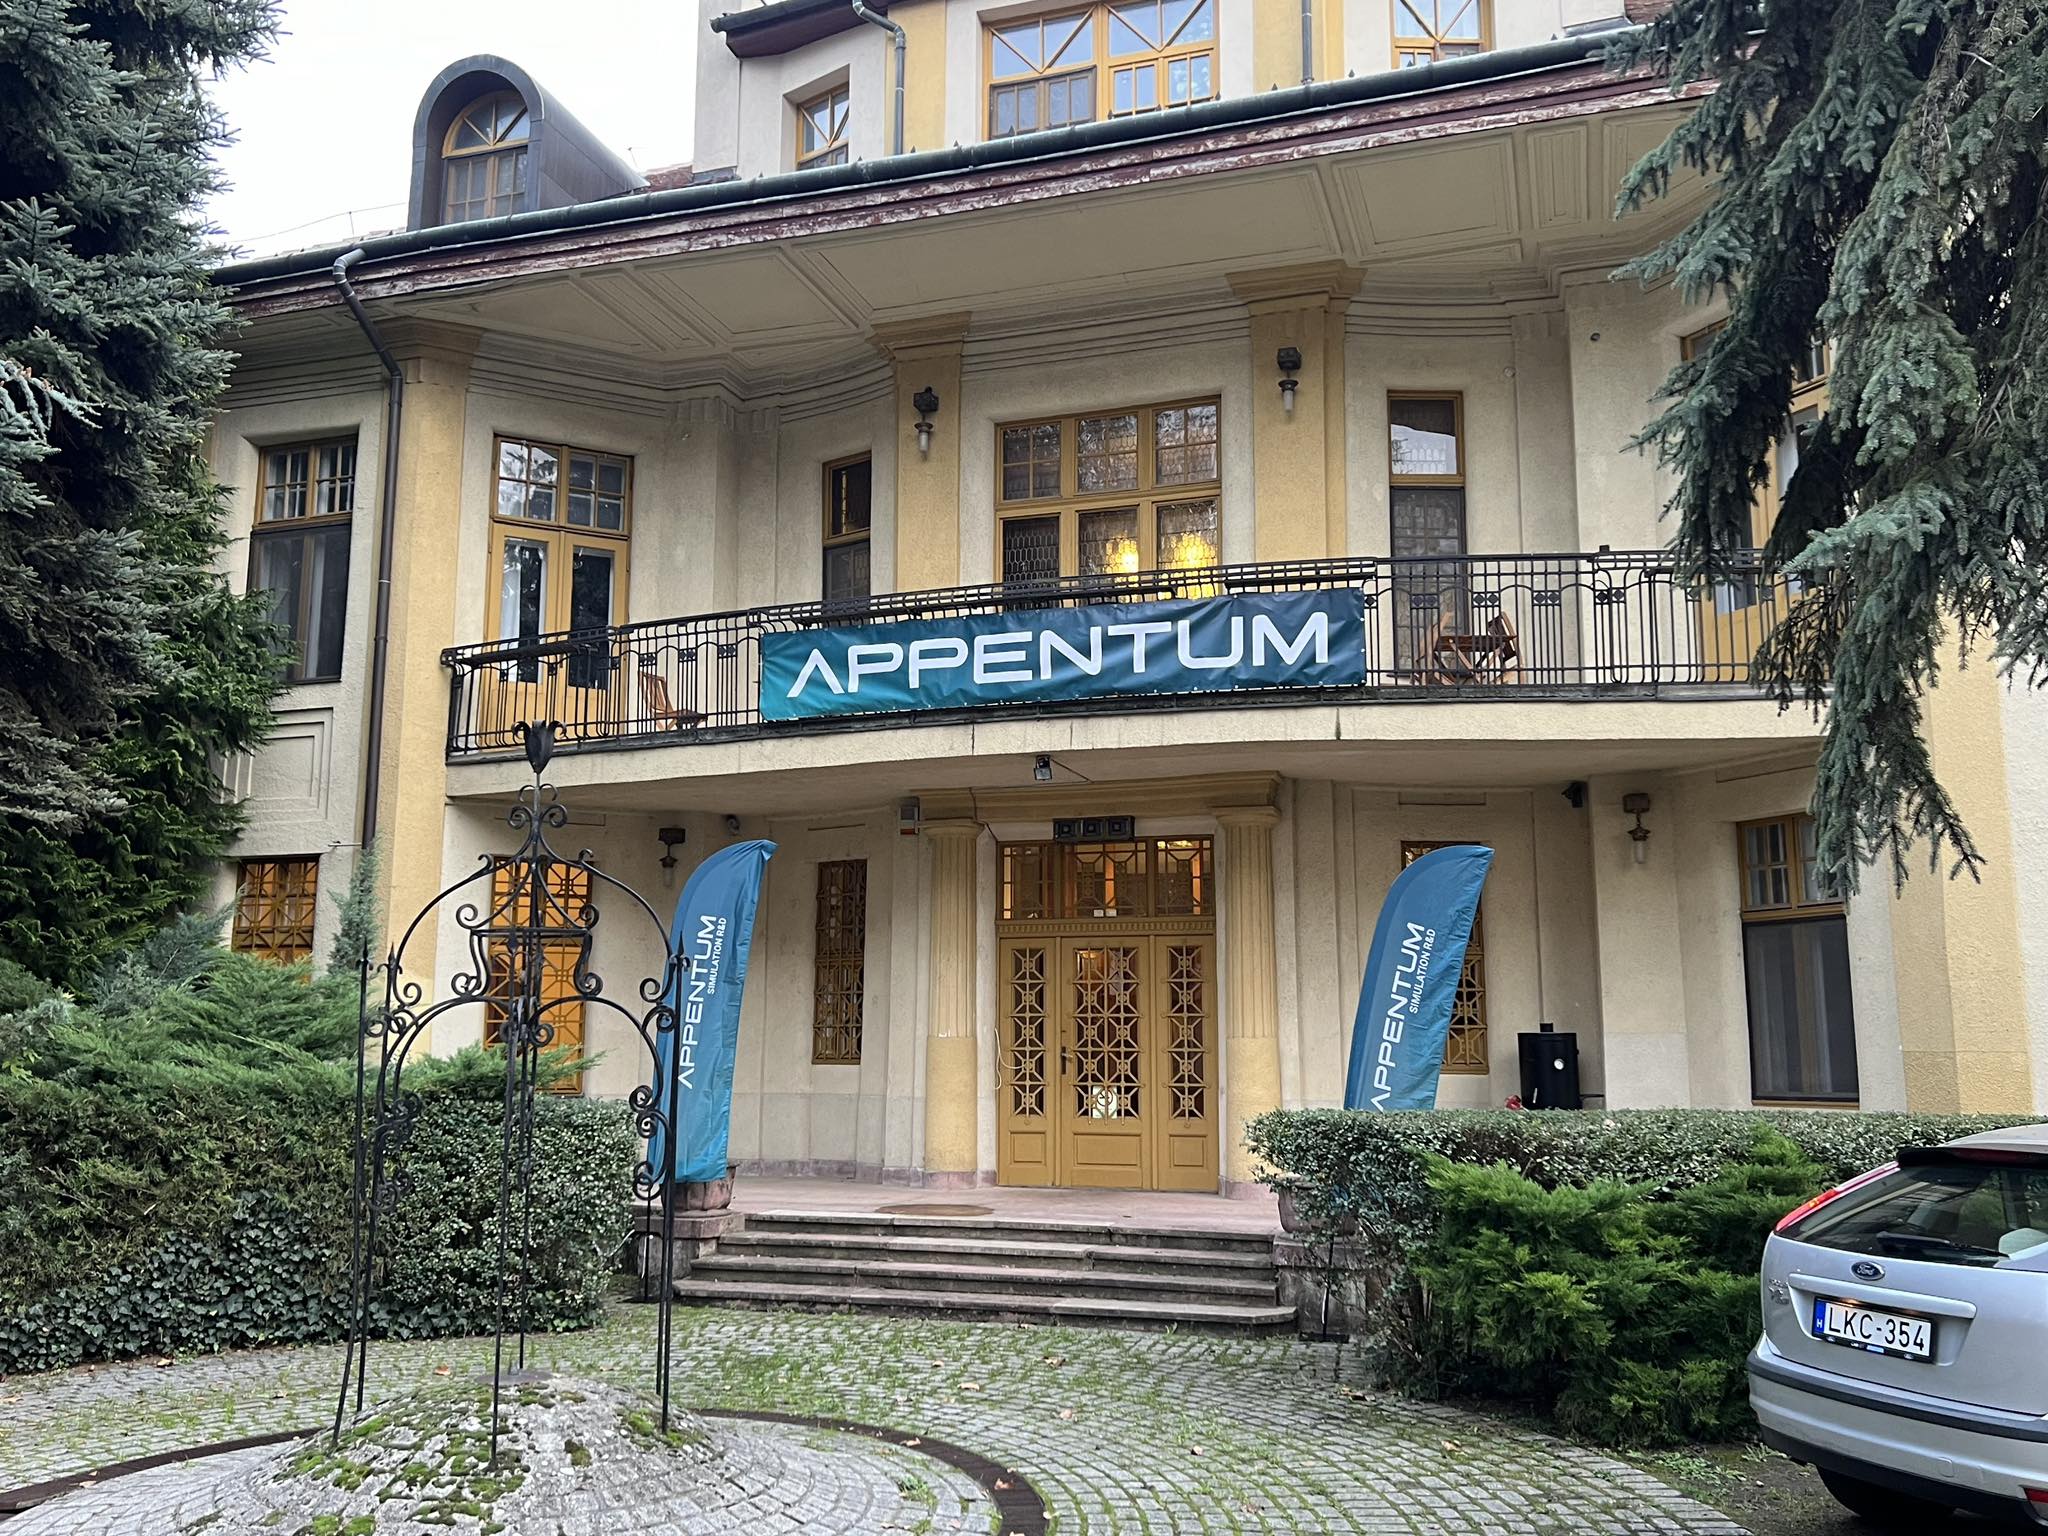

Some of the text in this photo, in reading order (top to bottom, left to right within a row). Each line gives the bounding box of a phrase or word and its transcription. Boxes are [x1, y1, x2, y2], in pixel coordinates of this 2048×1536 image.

[786, 611, 1329, 698] APPENTUM
[707, 917, 727, 995] SIMULATION R&D
[1409, 928, 1436, 1014] SIMULATION R&D
[677, 915, 717, 1089] APPENTUM
[1370, 922, 1425, 1113] APPENTUM
[1816, 1318, 1823, 1328] H
[1828, 1307, 1925, 1351] LKC-354
